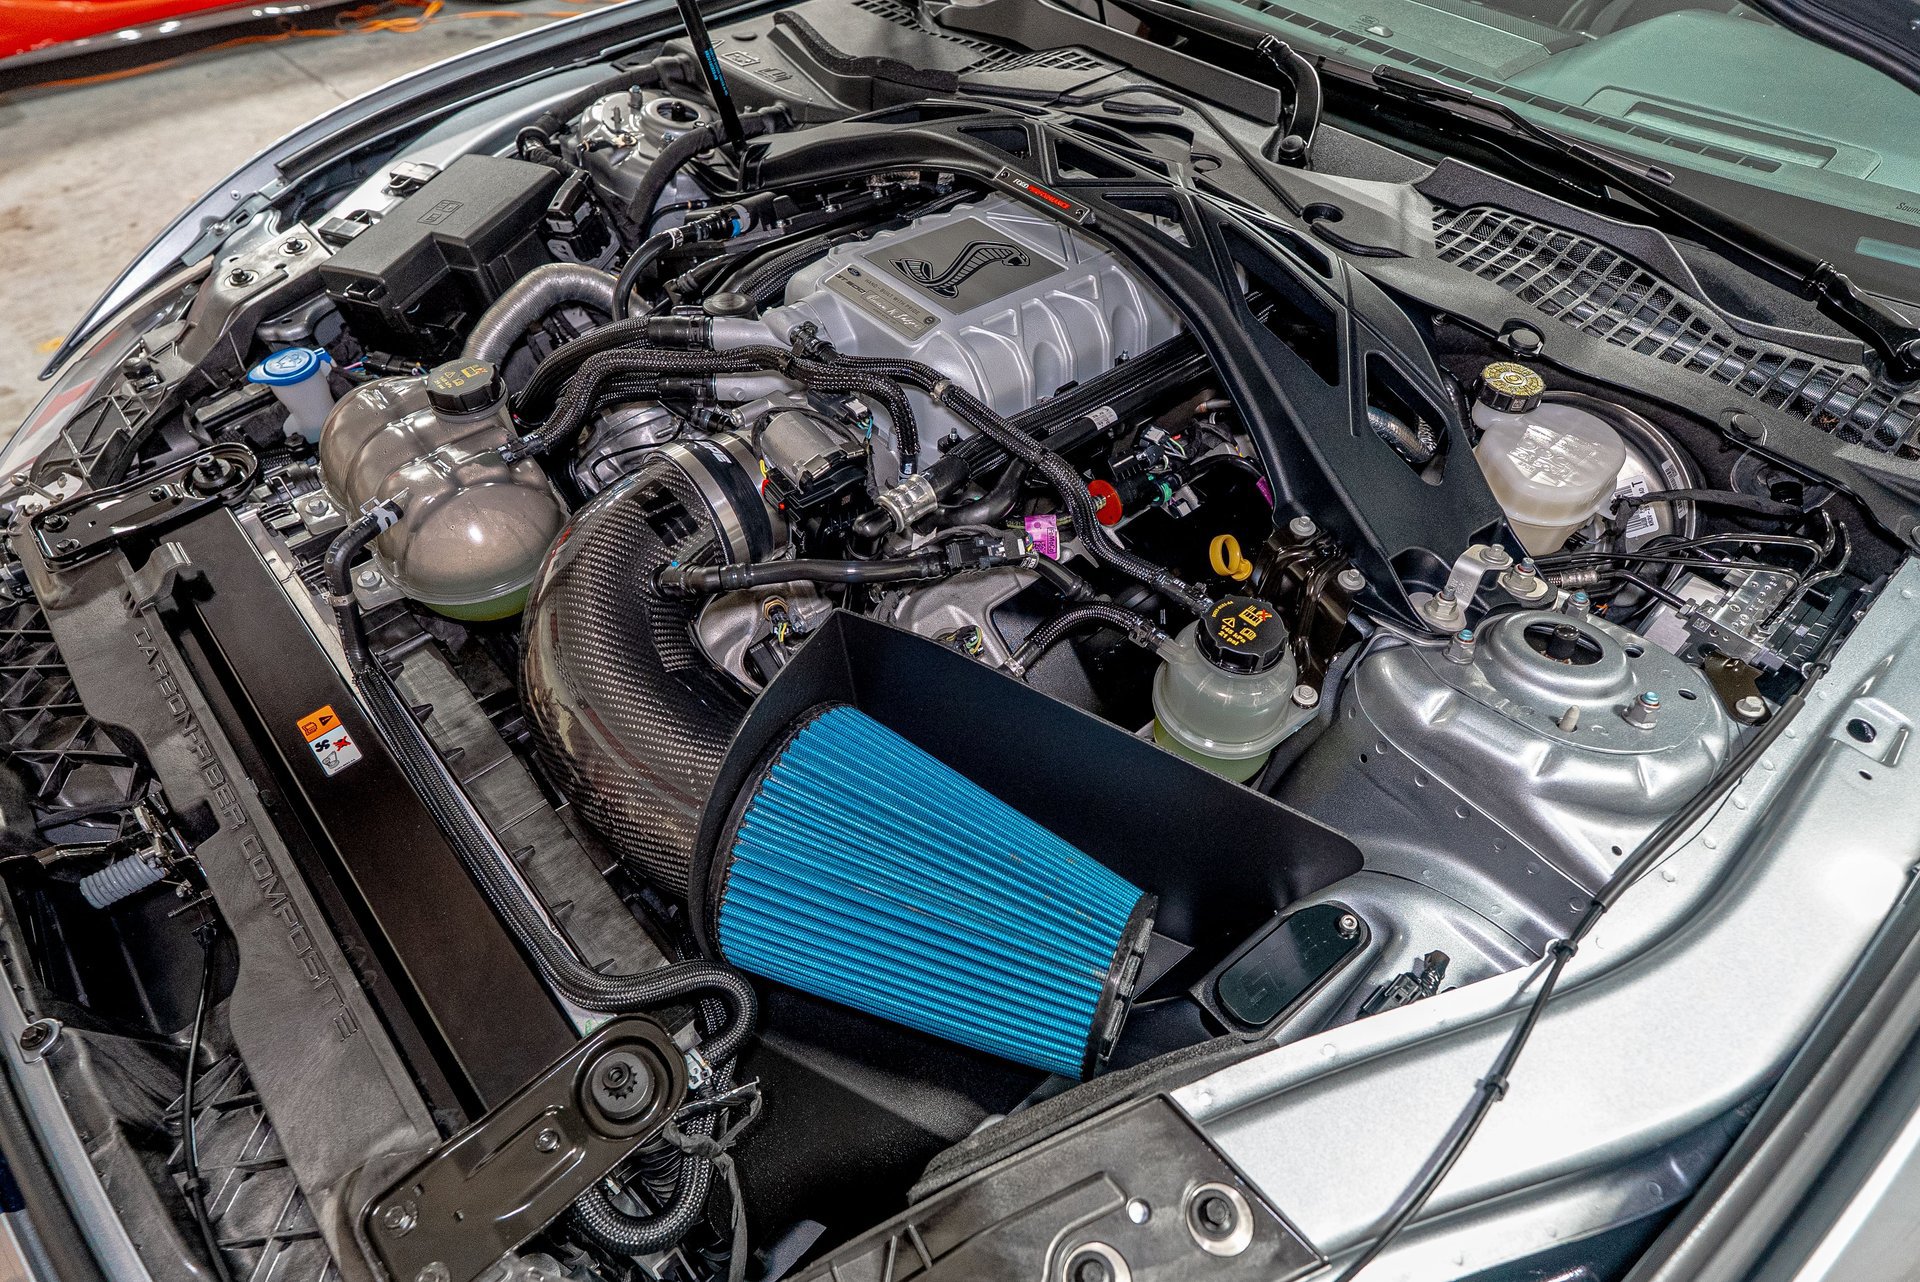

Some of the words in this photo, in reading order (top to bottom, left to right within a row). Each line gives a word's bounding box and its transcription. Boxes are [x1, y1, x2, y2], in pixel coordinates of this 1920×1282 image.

[1217, 630, 1228, 639] 21
[1226, 637, 1240, 646] psi
[1221, 624, 1234, 635] 145
[1233, 632, 1246, 644] kPa
[240, 833, 359, 1043] COMPOSITE
